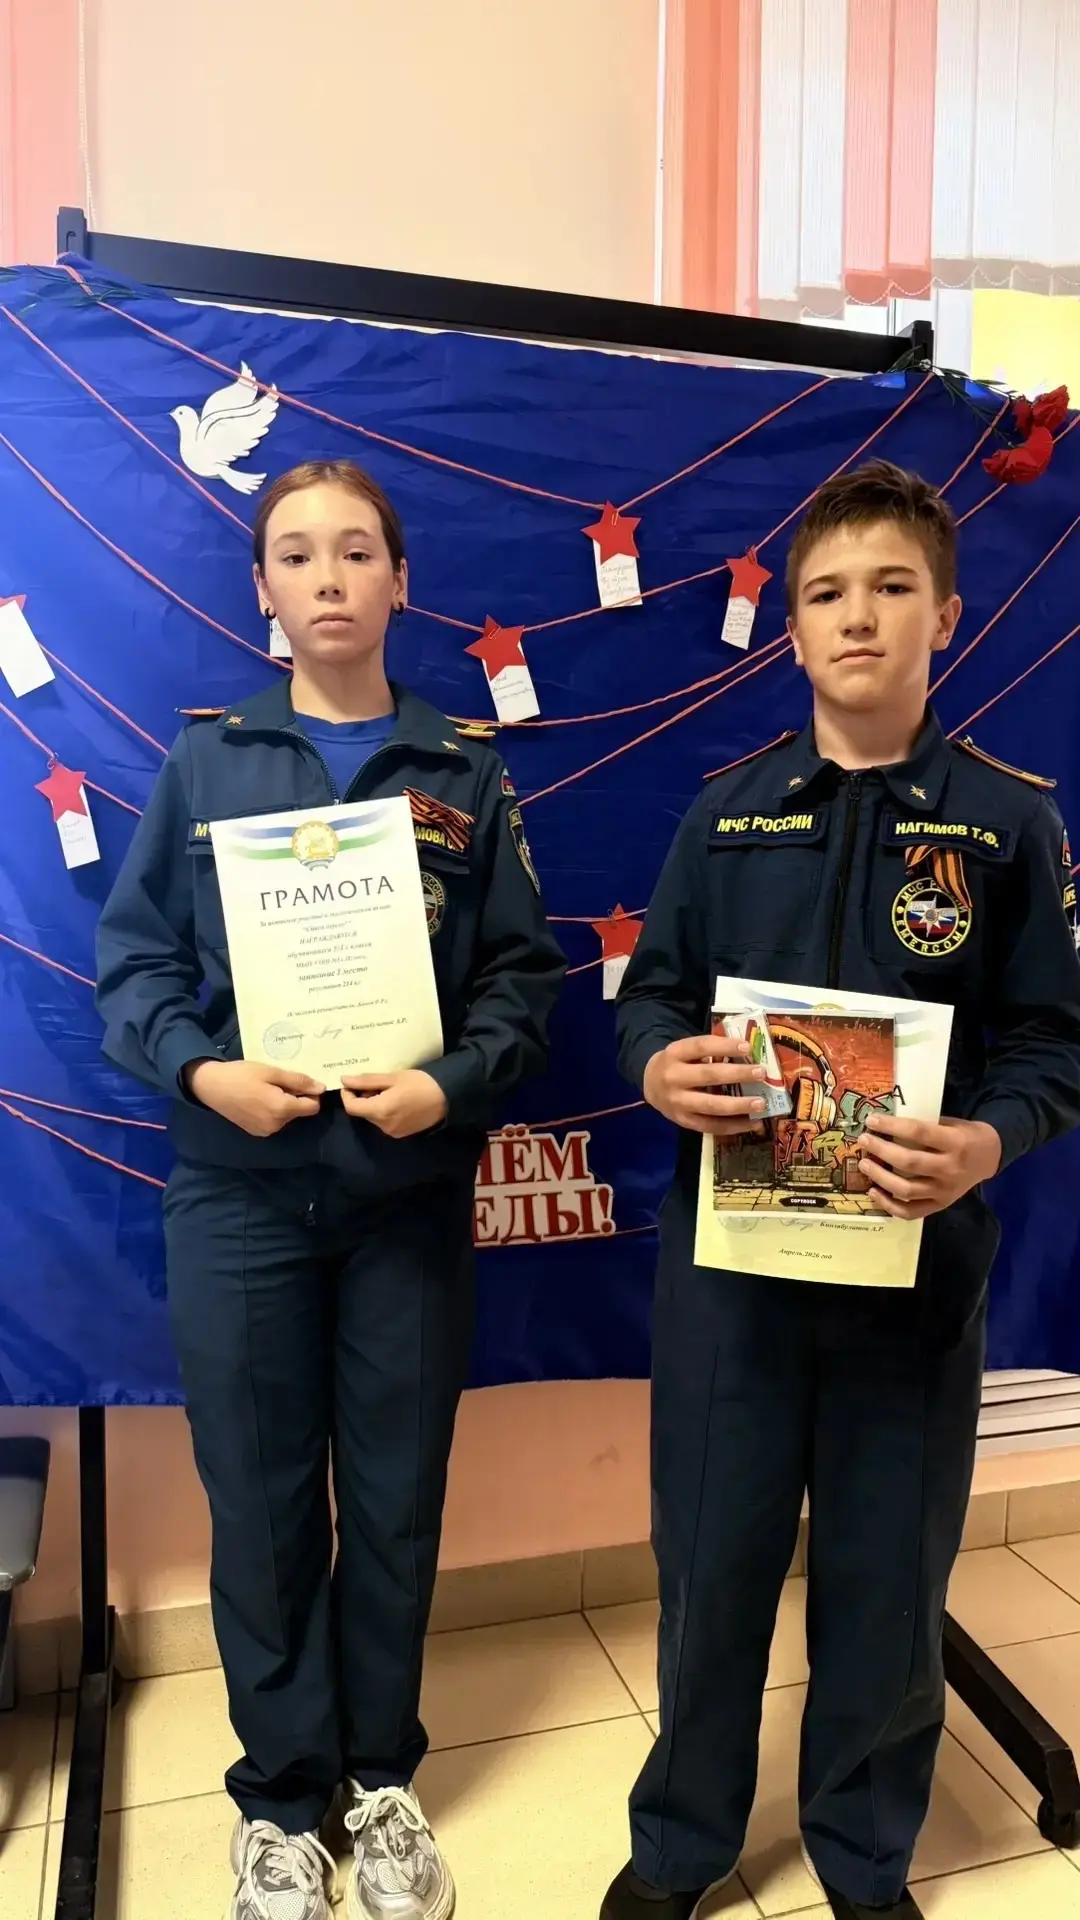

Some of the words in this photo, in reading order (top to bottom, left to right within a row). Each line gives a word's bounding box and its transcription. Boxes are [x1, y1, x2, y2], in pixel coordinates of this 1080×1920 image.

[717, 816, 750, 833] МЧС
[751, 814, 813, 832] РОССИИ
[895, 822, 968, 836] НАГИМОВ
[971, 827, 999, 849] Т.Ф.
[260, 875, 395, 911] ГРАМОТА
[896, 919, 963, 953] EMERCOM
[473, 1187, 613, 1244] ЕДЫ!
